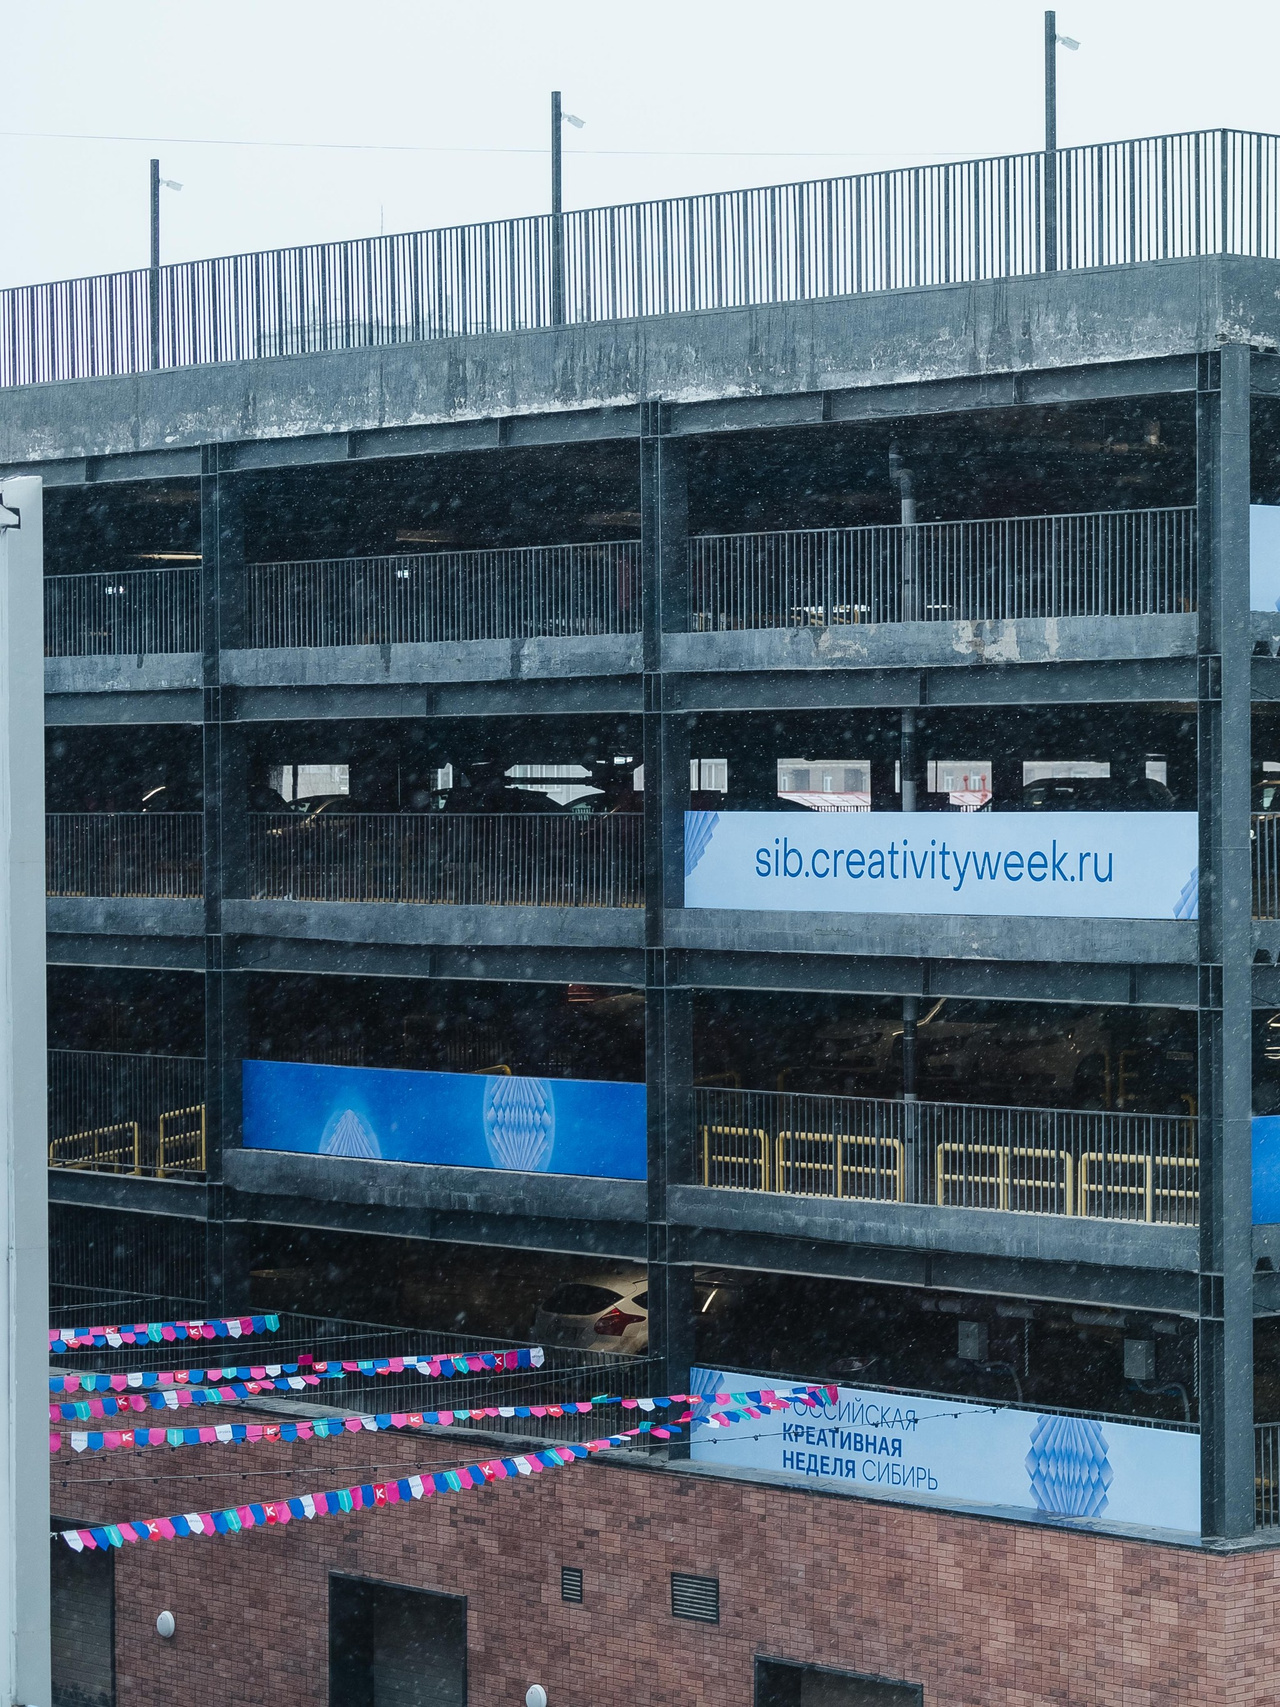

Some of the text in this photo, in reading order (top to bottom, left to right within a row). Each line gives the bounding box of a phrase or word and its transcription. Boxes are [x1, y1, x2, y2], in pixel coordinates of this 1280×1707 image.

[755, 837, 1114, 892] sib.creativityweek.ru
[783, 1396, 916, 1432] ОССИЙСКАЯ
[783, 1422, 902, 1457] КРЕАТИВНАЯ
[783, 1450, 939, 1490] НЕДЕЛЯ СИБИРЬ
